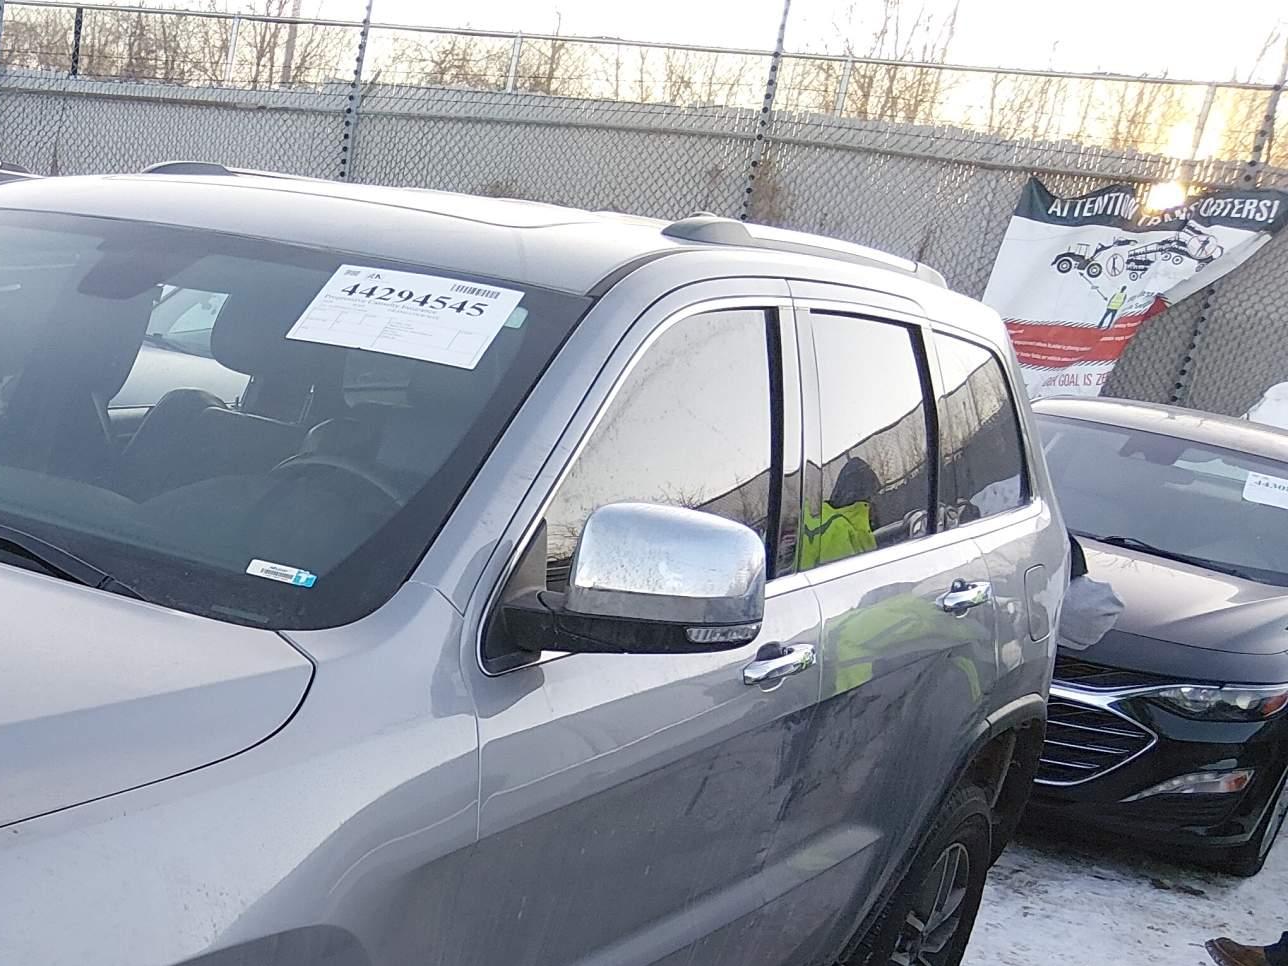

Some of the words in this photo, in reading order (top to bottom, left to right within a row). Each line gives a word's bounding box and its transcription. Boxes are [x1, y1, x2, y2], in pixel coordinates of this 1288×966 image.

[1048, 192, 1140, 220] ATTENTION
[340, 282, 489, 317] 44294545
[1058, 373, 1080, 387] GOAL
[1083, 373, 1093, 386] IS
